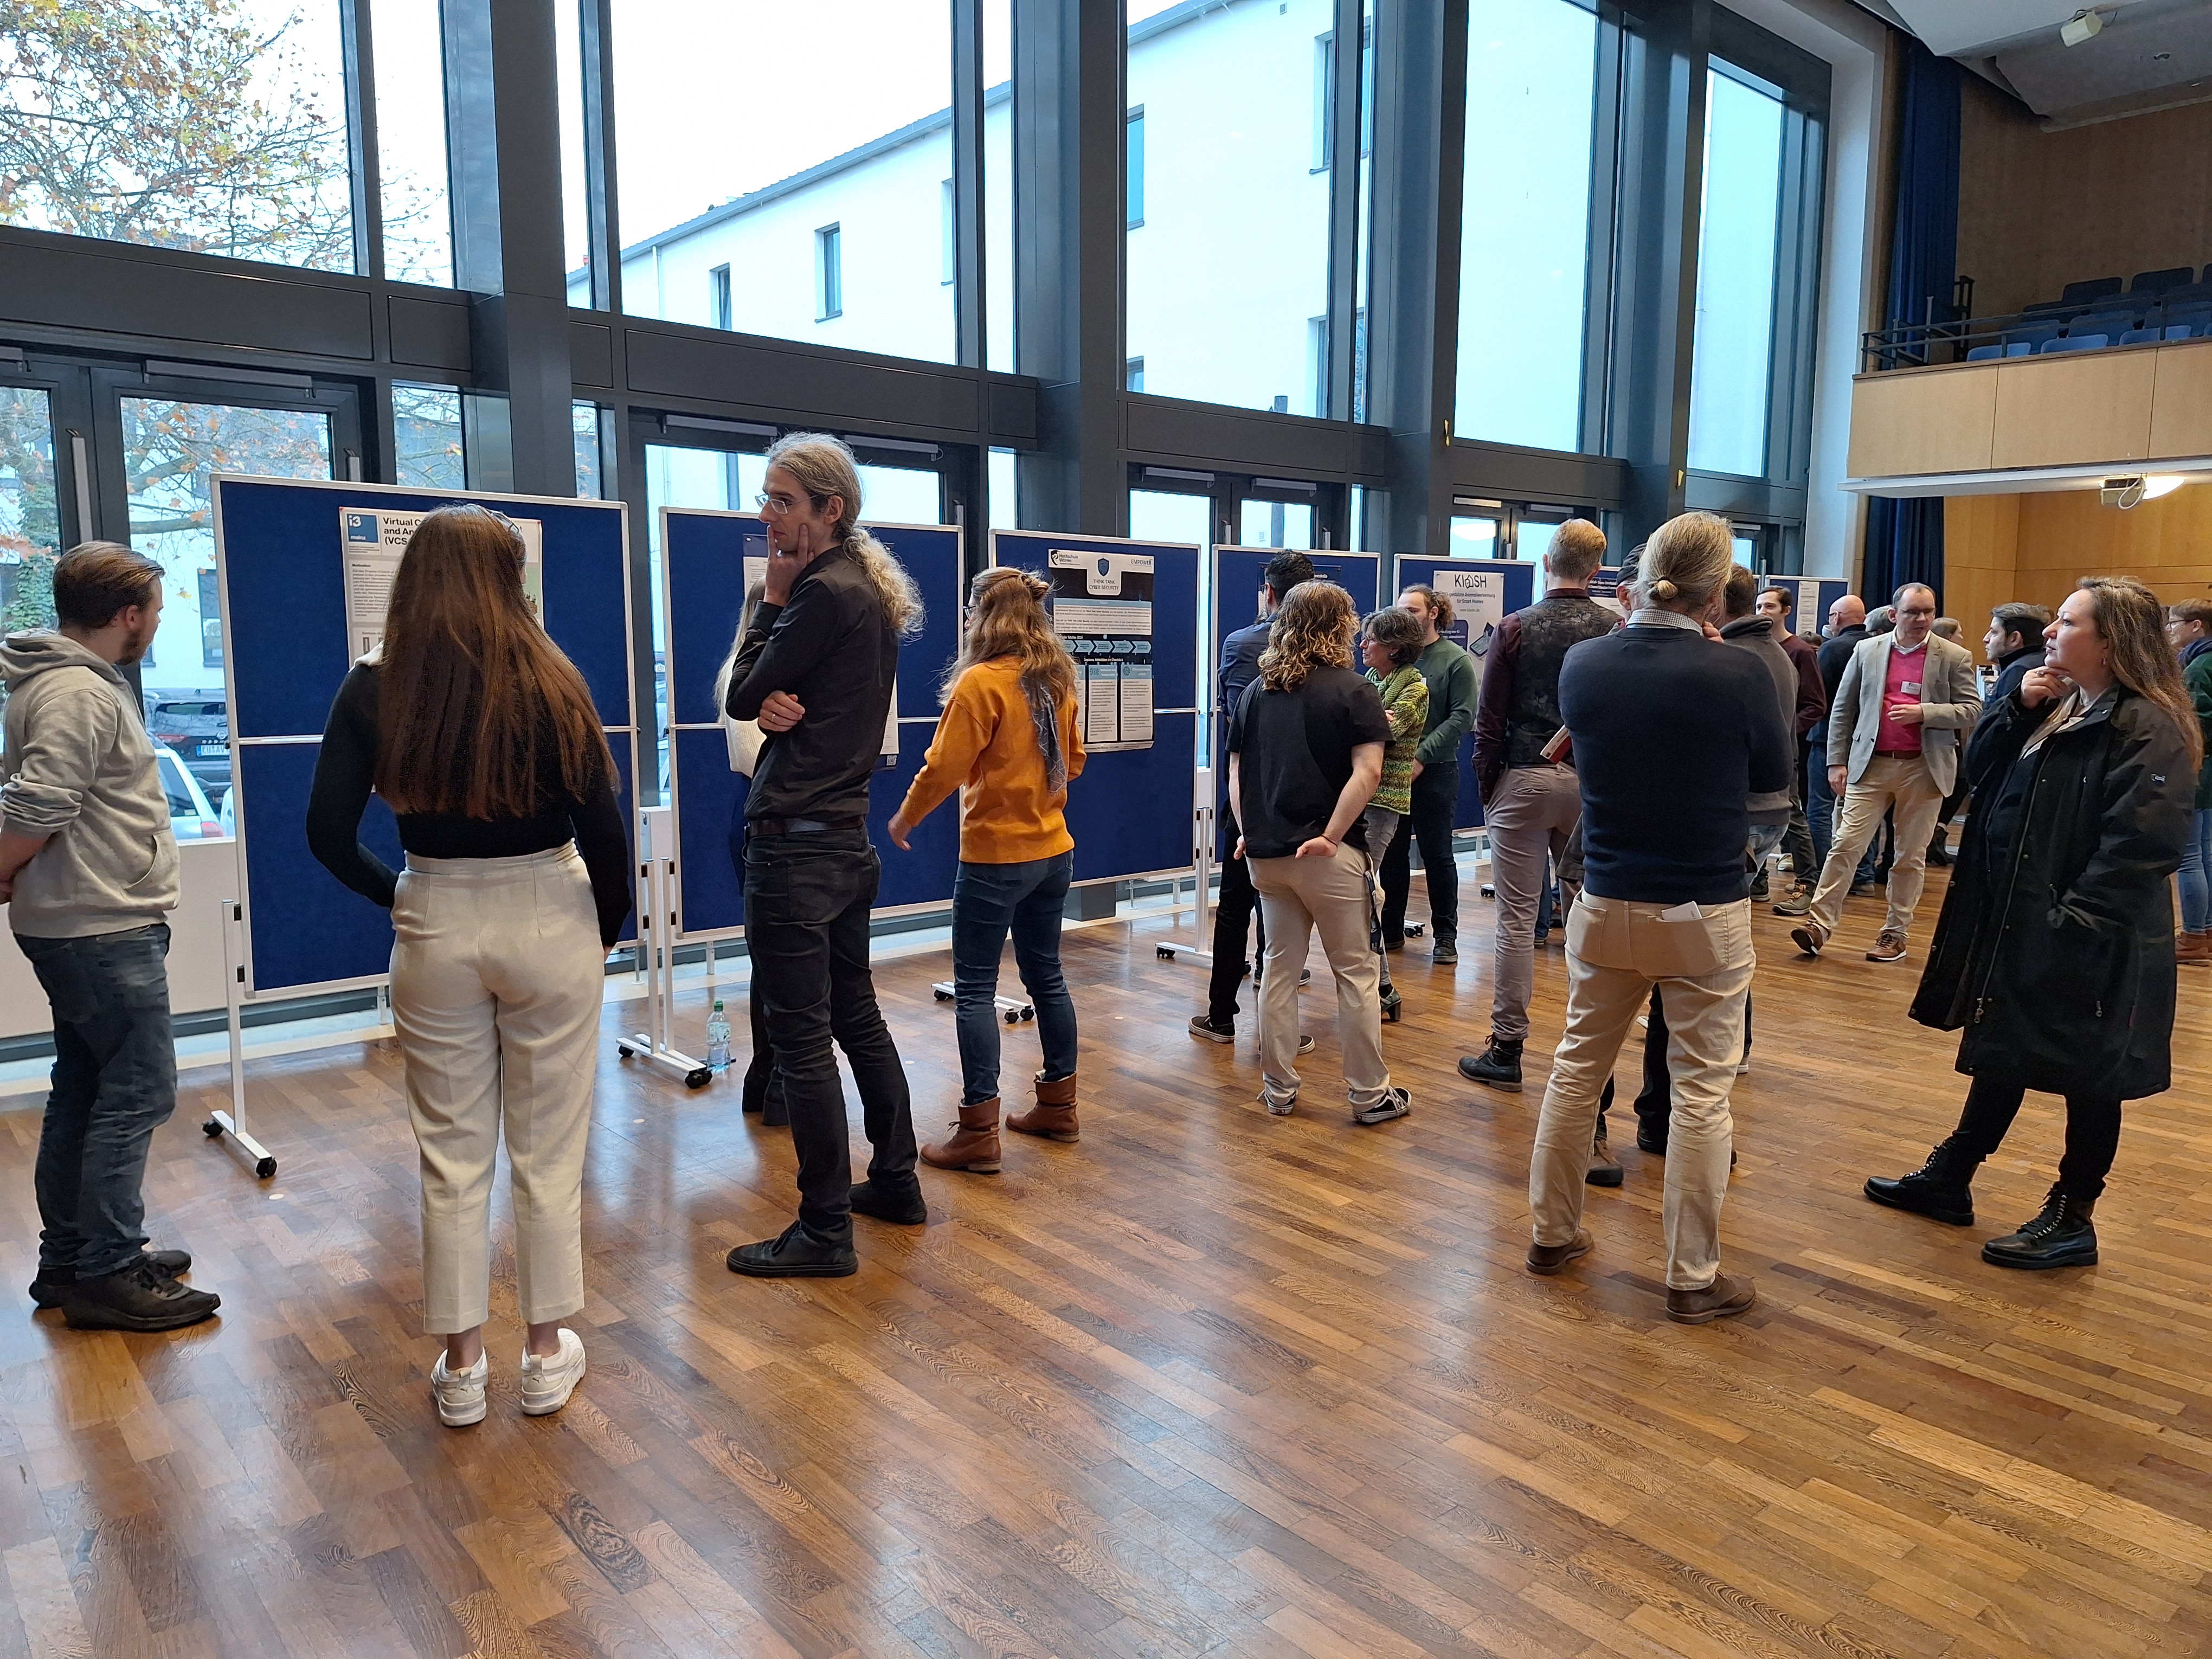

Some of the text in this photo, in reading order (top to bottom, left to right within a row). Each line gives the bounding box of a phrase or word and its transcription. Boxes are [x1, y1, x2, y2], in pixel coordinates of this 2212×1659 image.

[349, 515, 361, 527] i3
[383, 517, 413, 526] Virtual
[385, 537, 408, 545] (VCS
